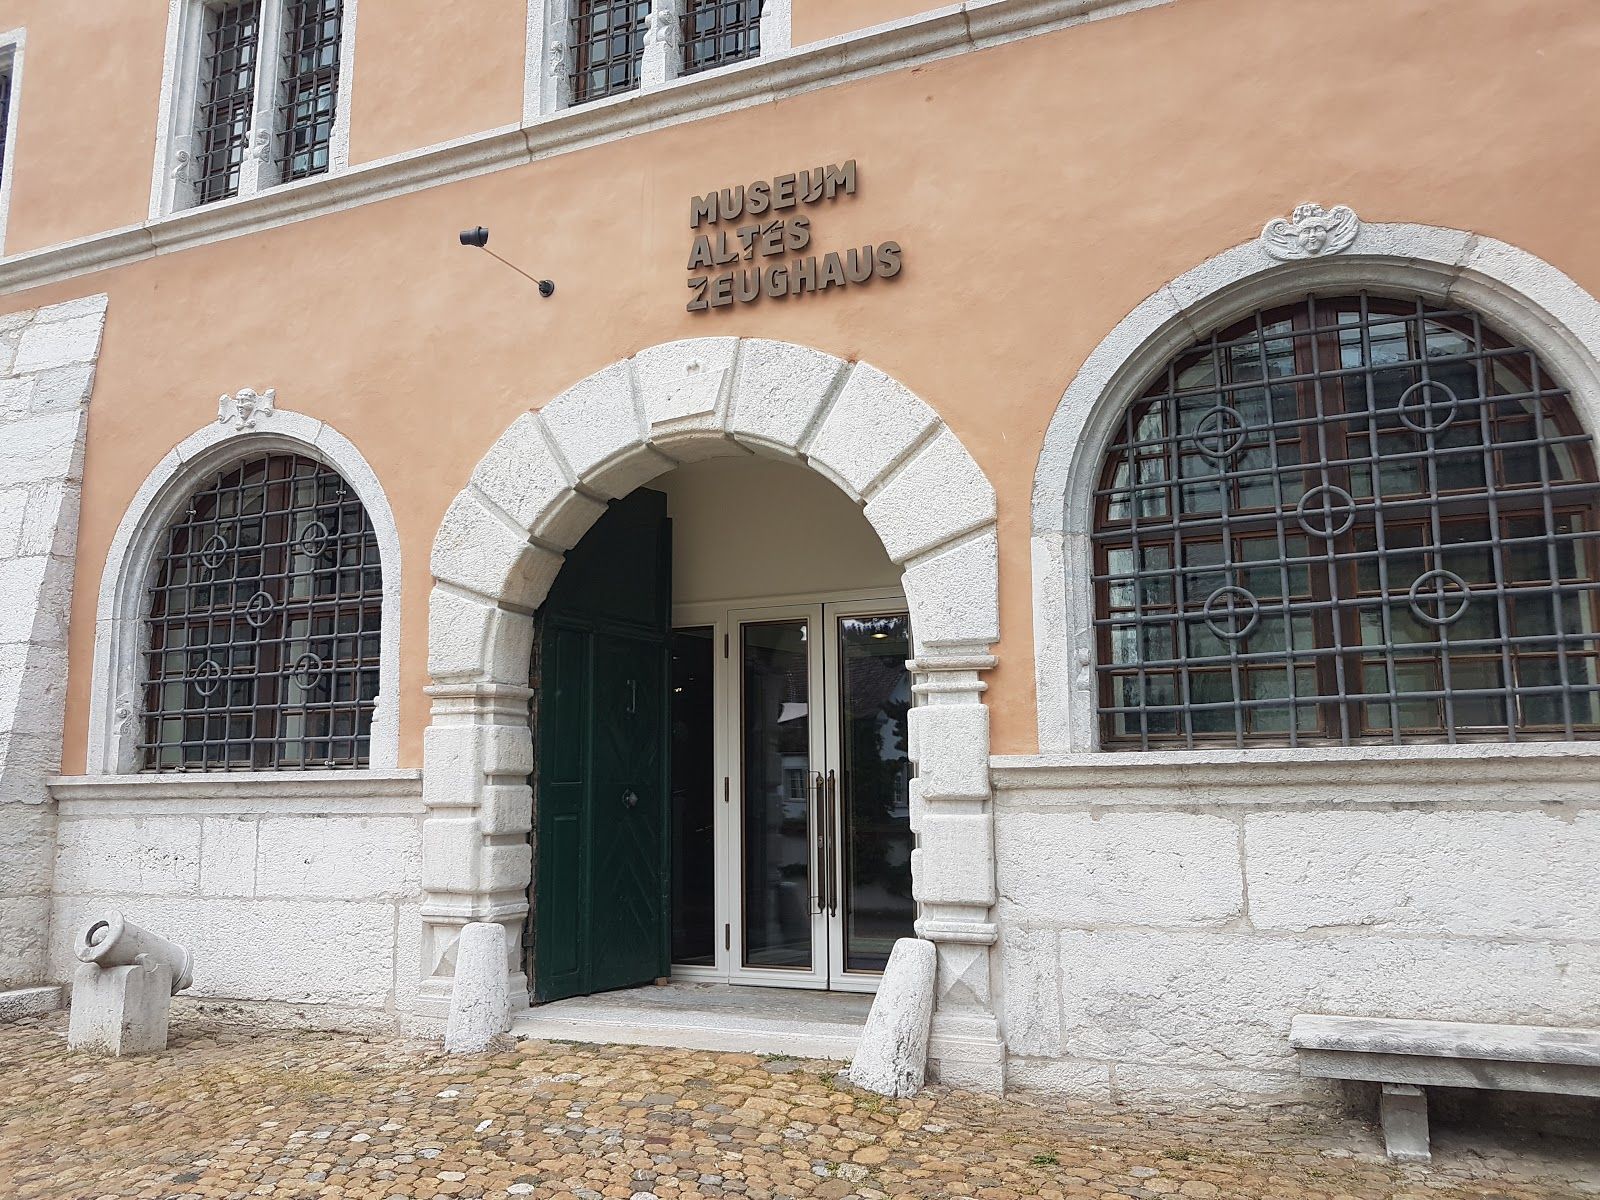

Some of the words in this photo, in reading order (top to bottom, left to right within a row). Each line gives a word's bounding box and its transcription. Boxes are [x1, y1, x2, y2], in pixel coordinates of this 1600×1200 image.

[690, 159, 856, 229] MUSEUM
[686, 241, 902, 312] ZEUGHAUS
[687, 214, 810, 270] ALTES
